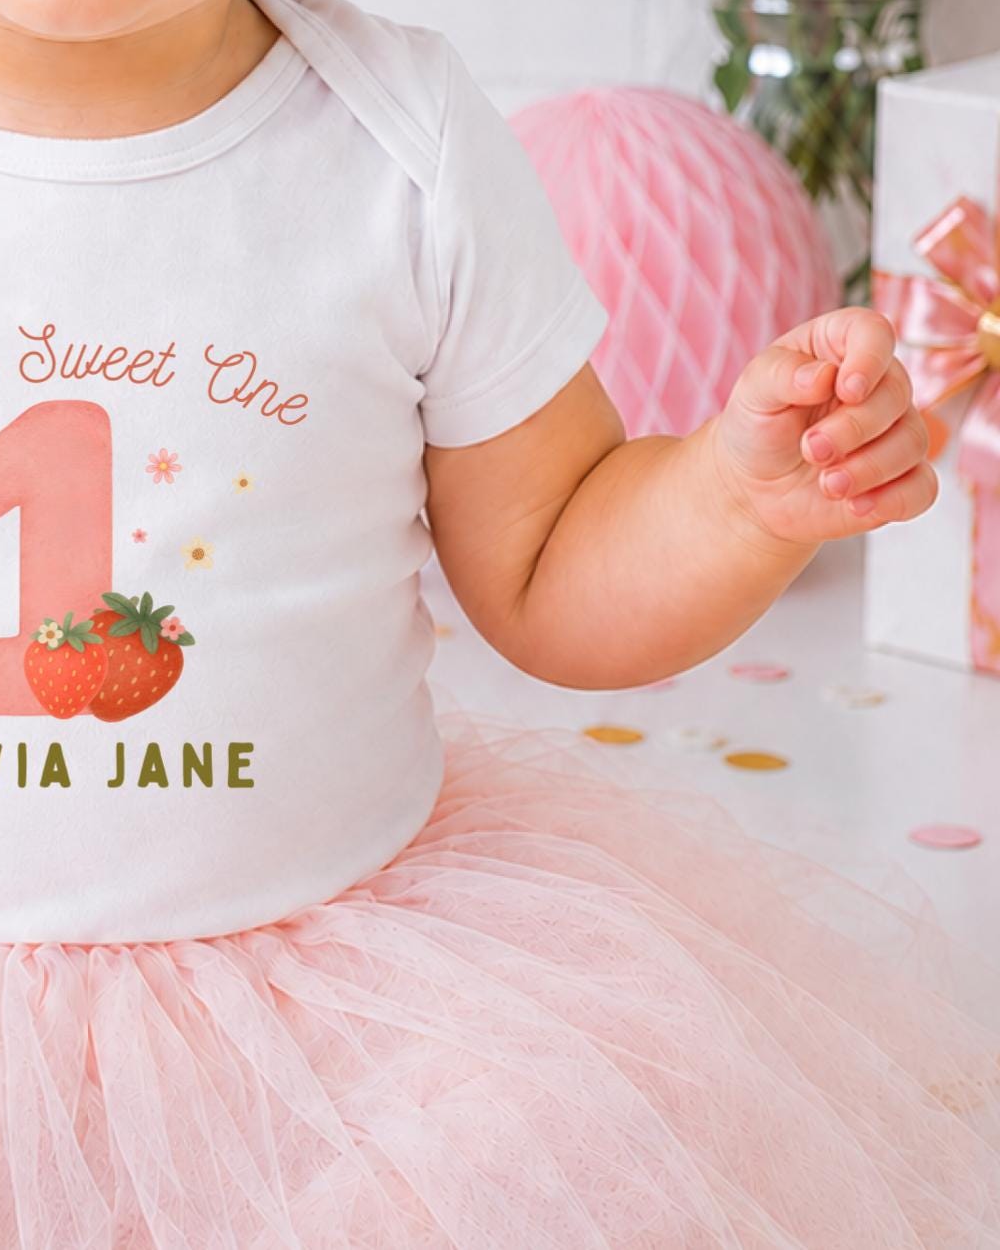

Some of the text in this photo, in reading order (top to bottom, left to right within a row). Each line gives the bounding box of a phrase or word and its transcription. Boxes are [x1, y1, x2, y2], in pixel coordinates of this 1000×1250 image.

[18, 323, 177, 387] Sweet
[204, 343, 310, 426] One
[106, 741, 256, 789] JANE
